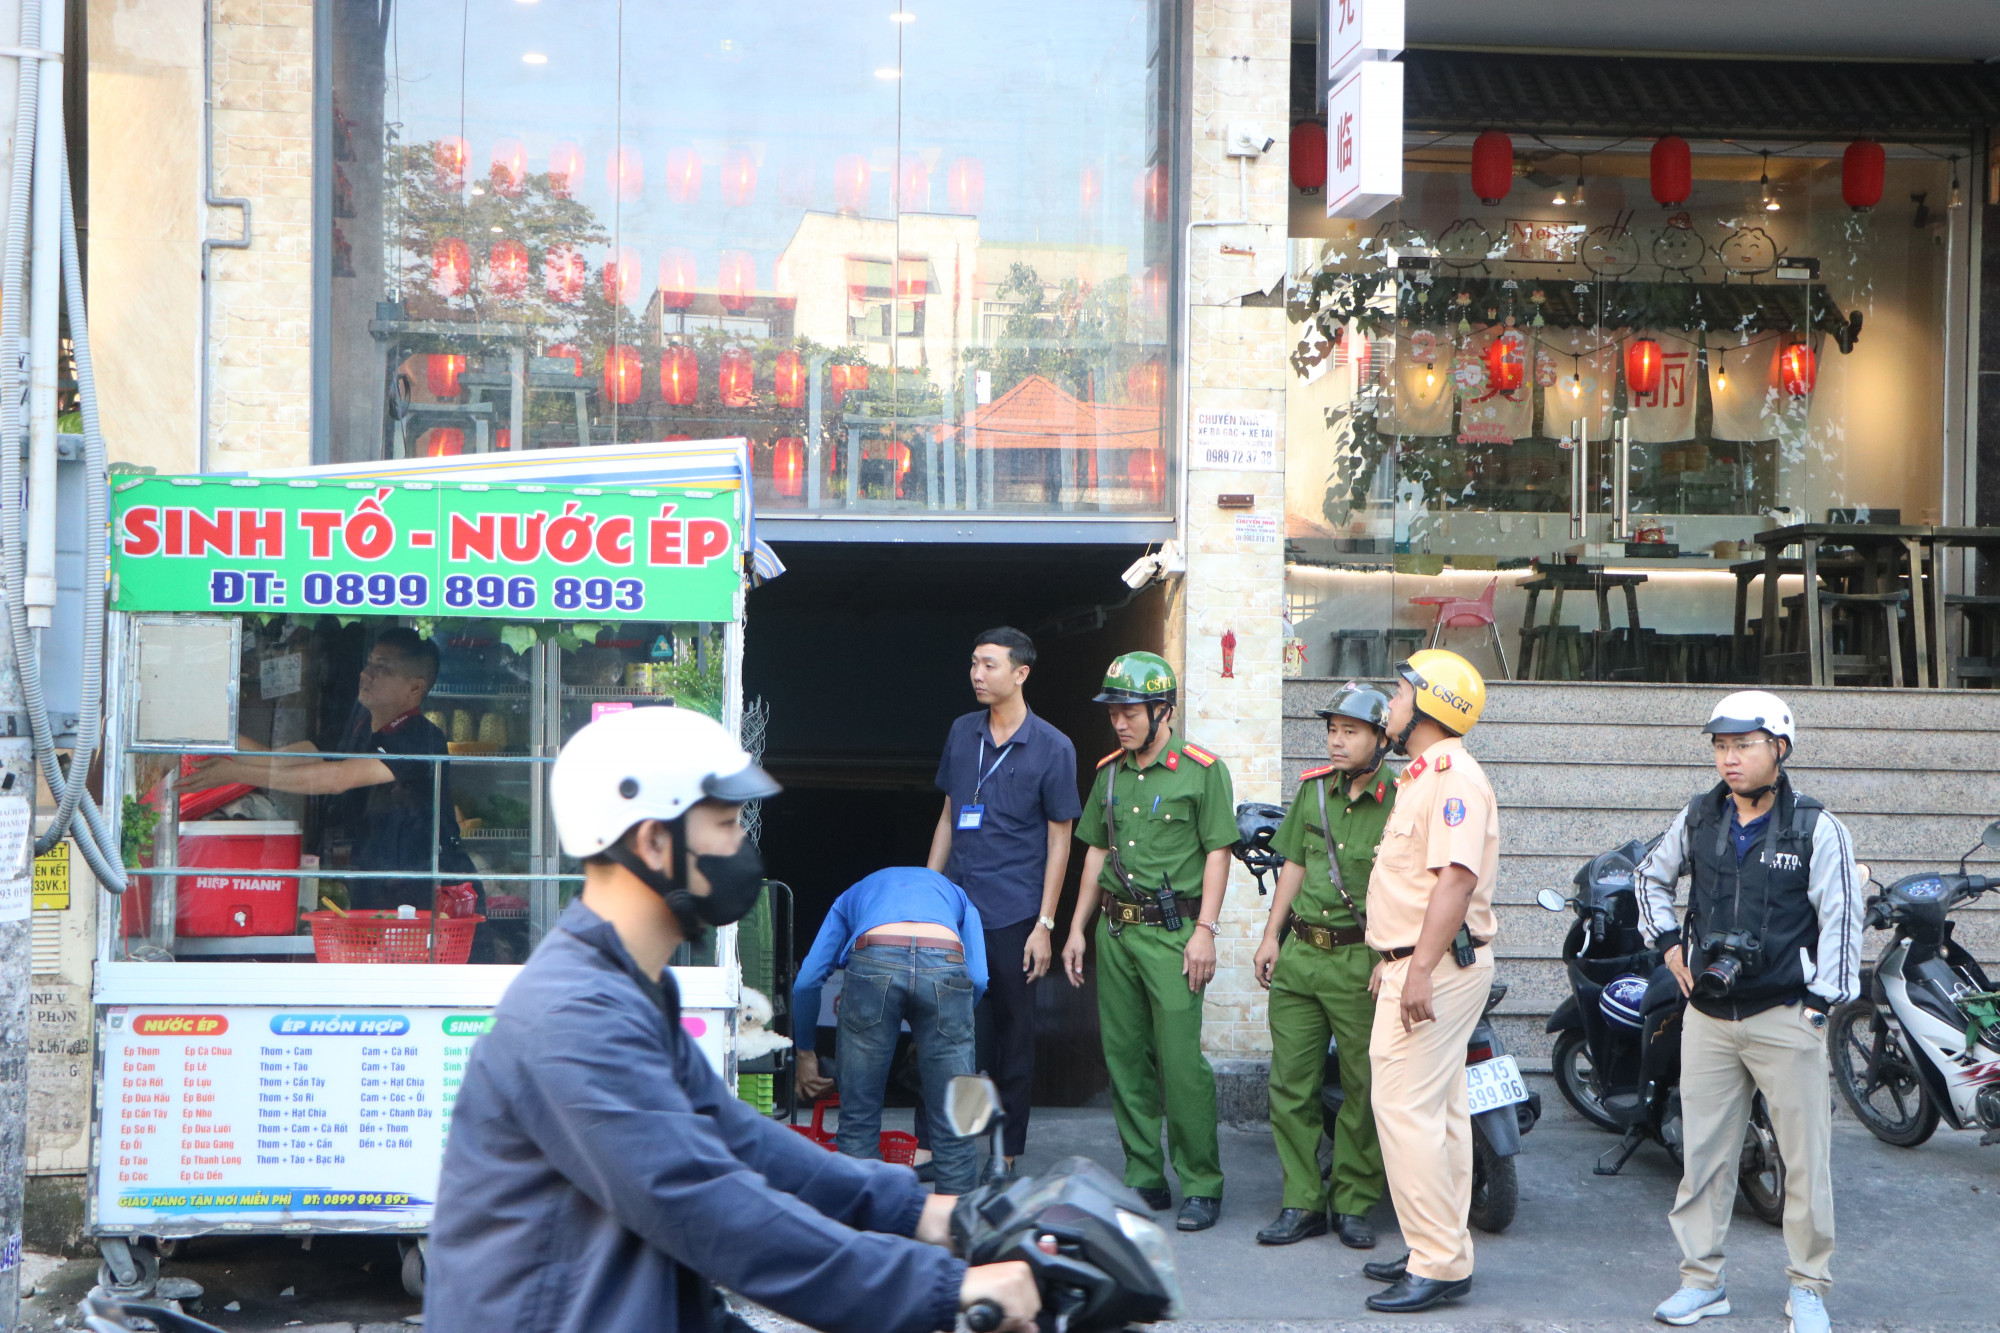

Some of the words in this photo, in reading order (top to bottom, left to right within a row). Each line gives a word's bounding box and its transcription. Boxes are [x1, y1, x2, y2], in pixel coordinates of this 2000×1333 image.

[1337, 112, 1352, 173] 临
[1206, 449, 1229, 463] 0989
[1232, 450, 1243, 463] 72
[1246, 451, 1257, 463] 37
[123, 506, 283, 559] SINH
[298, 487, 396, 561] TỐ
[450, 501, 634, 566] NƯỚC
[648, 503, 730, 568] ÉP
[209, 571, 286, 606] ĐT:
[302, 572, 428, 610] 0899
[443, 574, 536, 610] 896
[552, 576, 645, 612] 893
[1432, 684, 1473, 715] CSGT
[51, 862, 66, 876] KẾT
[144, 1016, 193, 1032] NƯỚC
[197, 1016, 218, 1032] ÉP
[281, 1018, 306, 1032] ÉP
[360, 1018, 404, 1036] HỢP
[450, 1021, 486, 1033] SINH
[124, 1046, 134, 1056] Ép
[185, 1046, 195, 1056] Ép
[211, 1046, 232, 1056] Chua
[294, 1046, 312, 1055] Cam
[362, 1047, 380, 1055] Cam
[444, 1047, 462, 1056] Sinh
[123, 1062, 134, 1072] Ép
[136, 1062, 155, 1071] Cam
[184, 1060, 195, 1072] Ép
[362, 1062, 380, 1071] Cam
[443, 1062, 461, 1071] Sinh
[123, 1077, 133, 1088] Ép
[184, 1076, 194, 1088] Ép
[361, 1077, 379, 1086] Cam
[406, 1077, 424, 1086] Chia
[122, 1093, 133, 1104] Ép
[184, 1093, 194, 1103] Ép
[361, 1093, 379, 1102] Cam
[122, 1108, 132, 1119] Ép
[183, 1108, 193, 1118] Ép
[196, 1108, 212, 1118] Nho
[308, 1108, 326, 1117] Chia
[360, 1108, 378, 1117] Cam
[390, 1108, 415, 1117] Chanh
[121, 1123, 132, 1135] Ép
[182, 1124, 192, 1134] Ép
[292, 1124, 310, 1132] Cam
[120, 1139, 131, 1150] Ép
[182, 1140, 192, 1150] Ép
[213, 1140, 234, 1149] Gang
[120, 1154, 130, 1166] Ép
[181, 1155, 191, 1165] Ép
[194, 1155, 219, 1164] Thanh
[222, 1156, 241, 1165] Long
[119, 1170, 130, 1182] Ép
[180, 1170, 191, 1182] Ép
[118, 1197, 149, 1208] GIAO
[152, 1194, 187, 1206] HÀNG
[190, 1193, 213, 1208] TẬN
[303, 1194, 320, 1206] ĐT:
[323, 1194, 355, 1205] 0899
[358, 1194, 382, 1205] 896
[384, 1194, 409, 1205] 893
